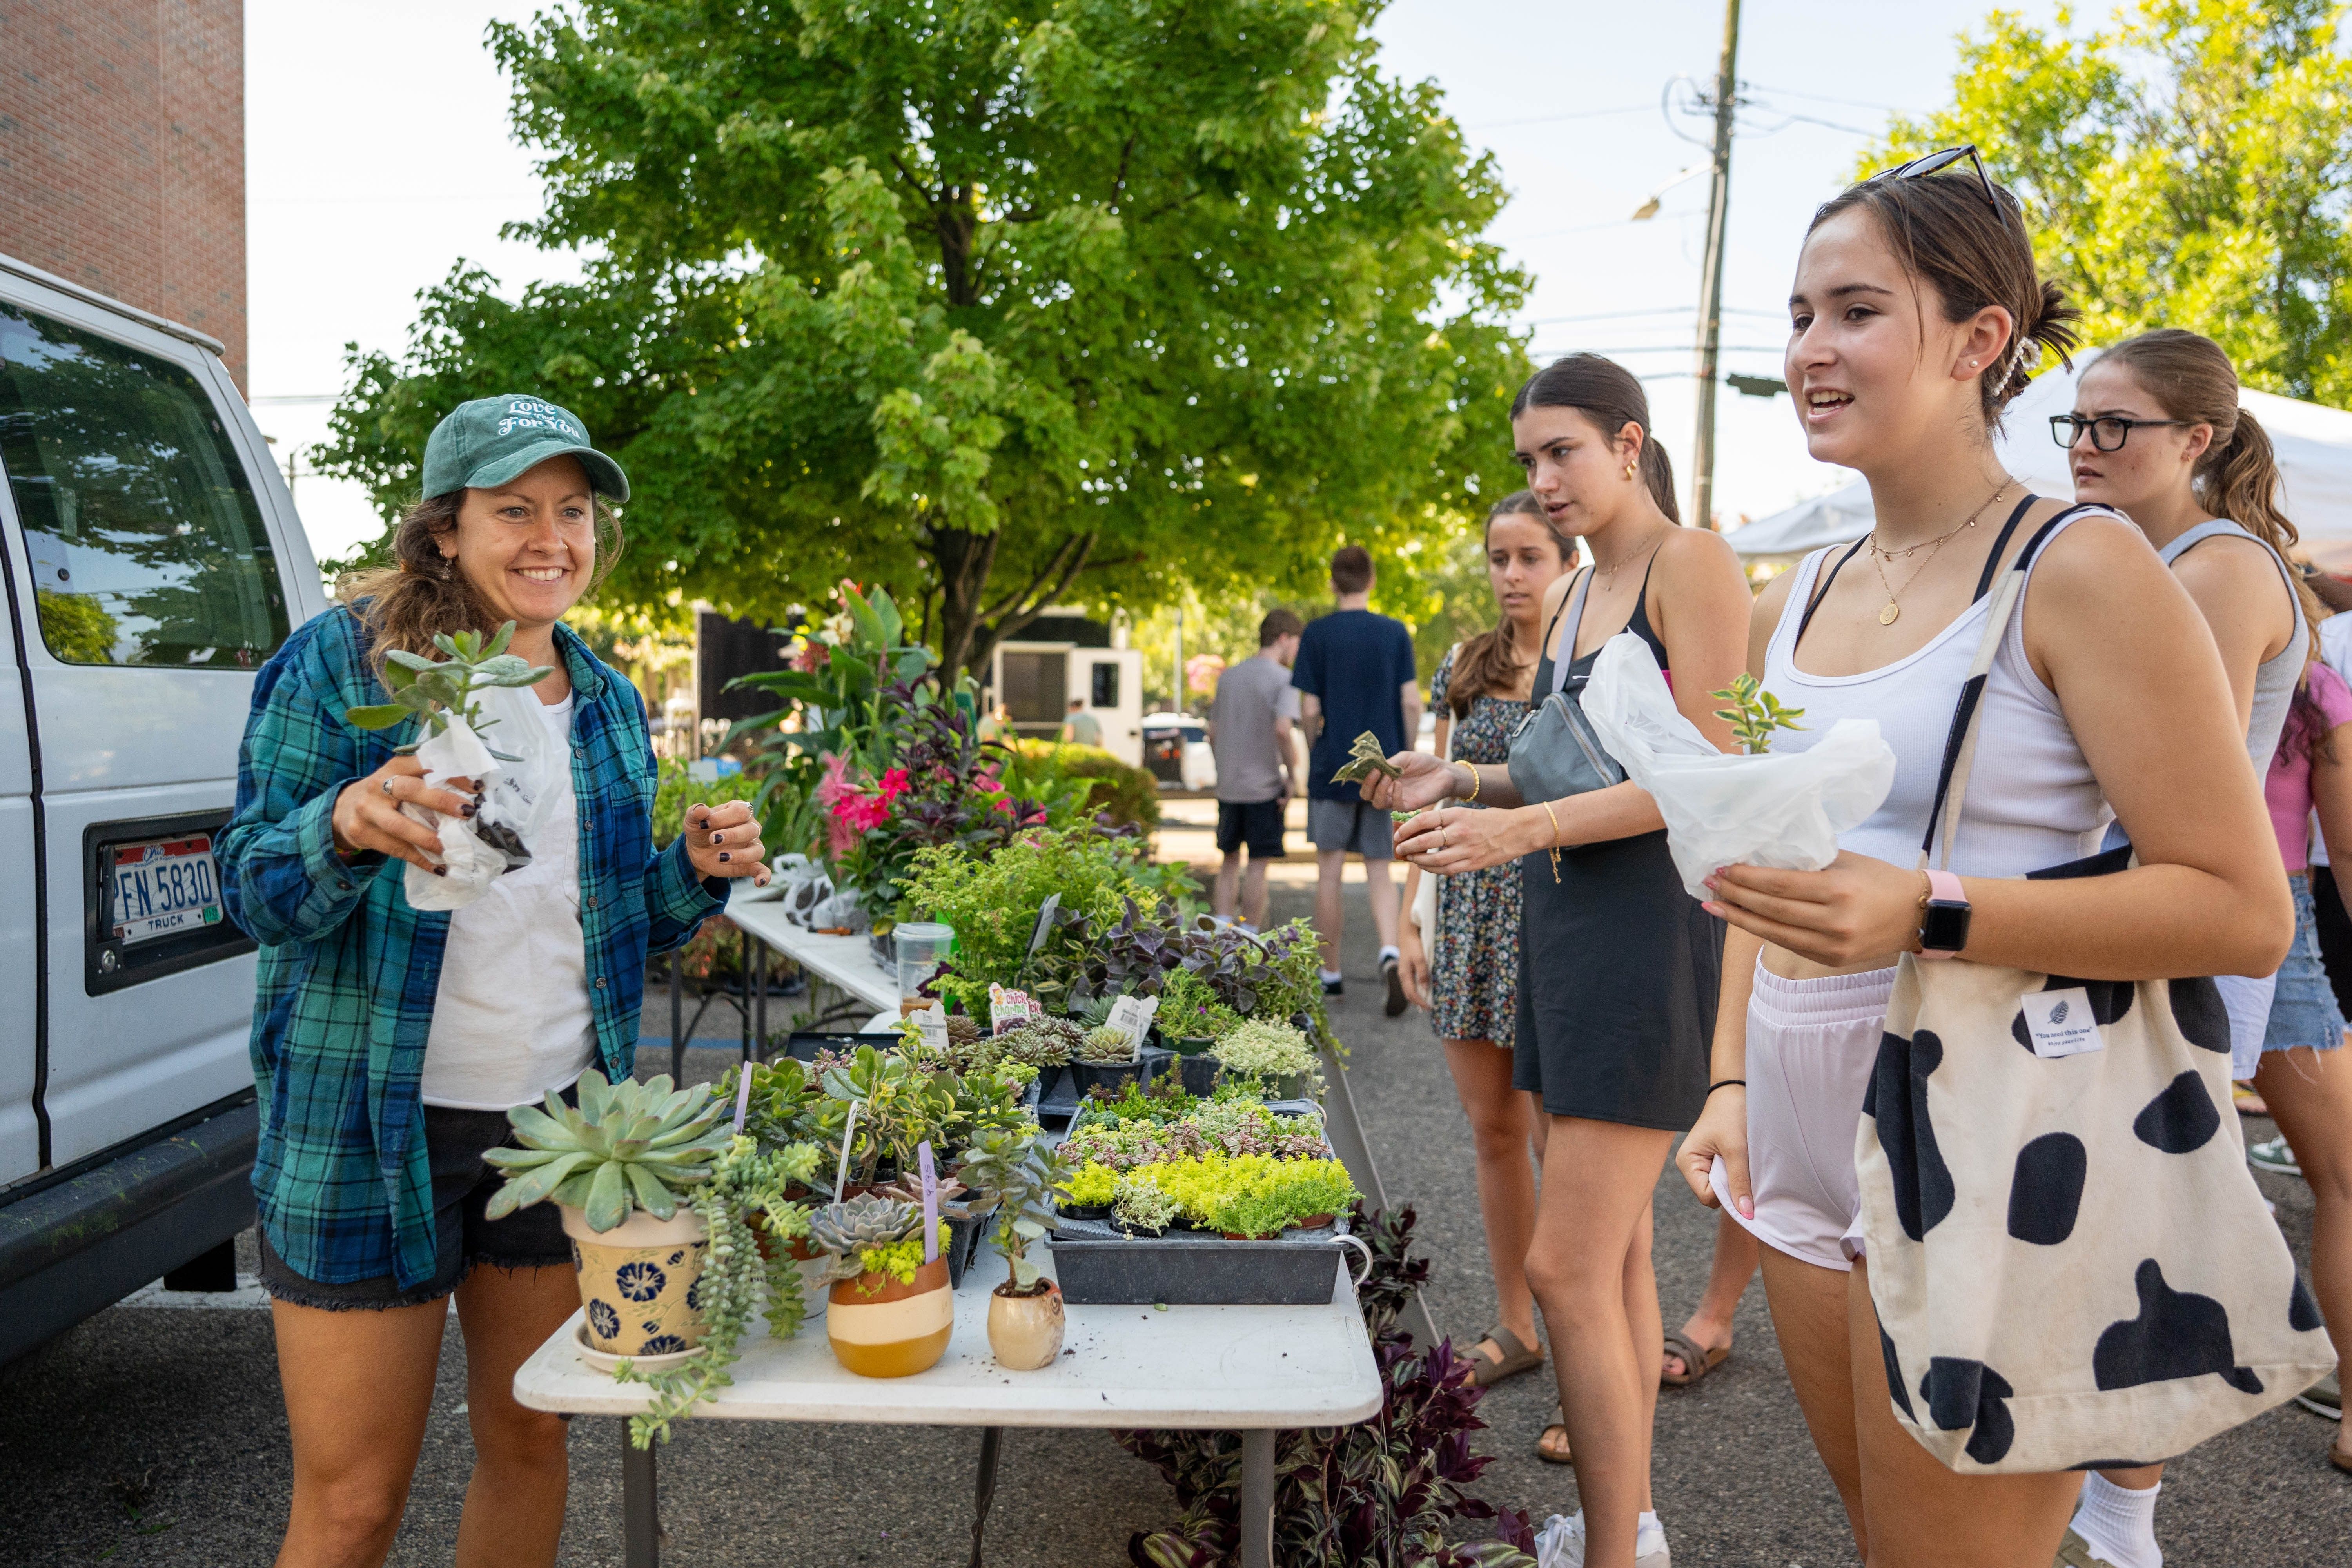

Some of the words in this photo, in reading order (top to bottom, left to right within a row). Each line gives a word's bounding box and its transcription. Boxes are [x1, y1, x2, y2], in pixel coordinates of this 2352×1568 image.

[509, 401, 556, 415] Love
[498, 417, 543, 436] For
[544, 419, 581, 439] You
[143, 845, 164, 861] Ohio
[156, 860, 212, 911] 5830
[148, 914, 184, 931] TRUCK
[1006, 993, 1027, 1004] Chick
[994, 1004, 1027, 1016] Charms
[925, 1164, 935, 1196] 9.95
